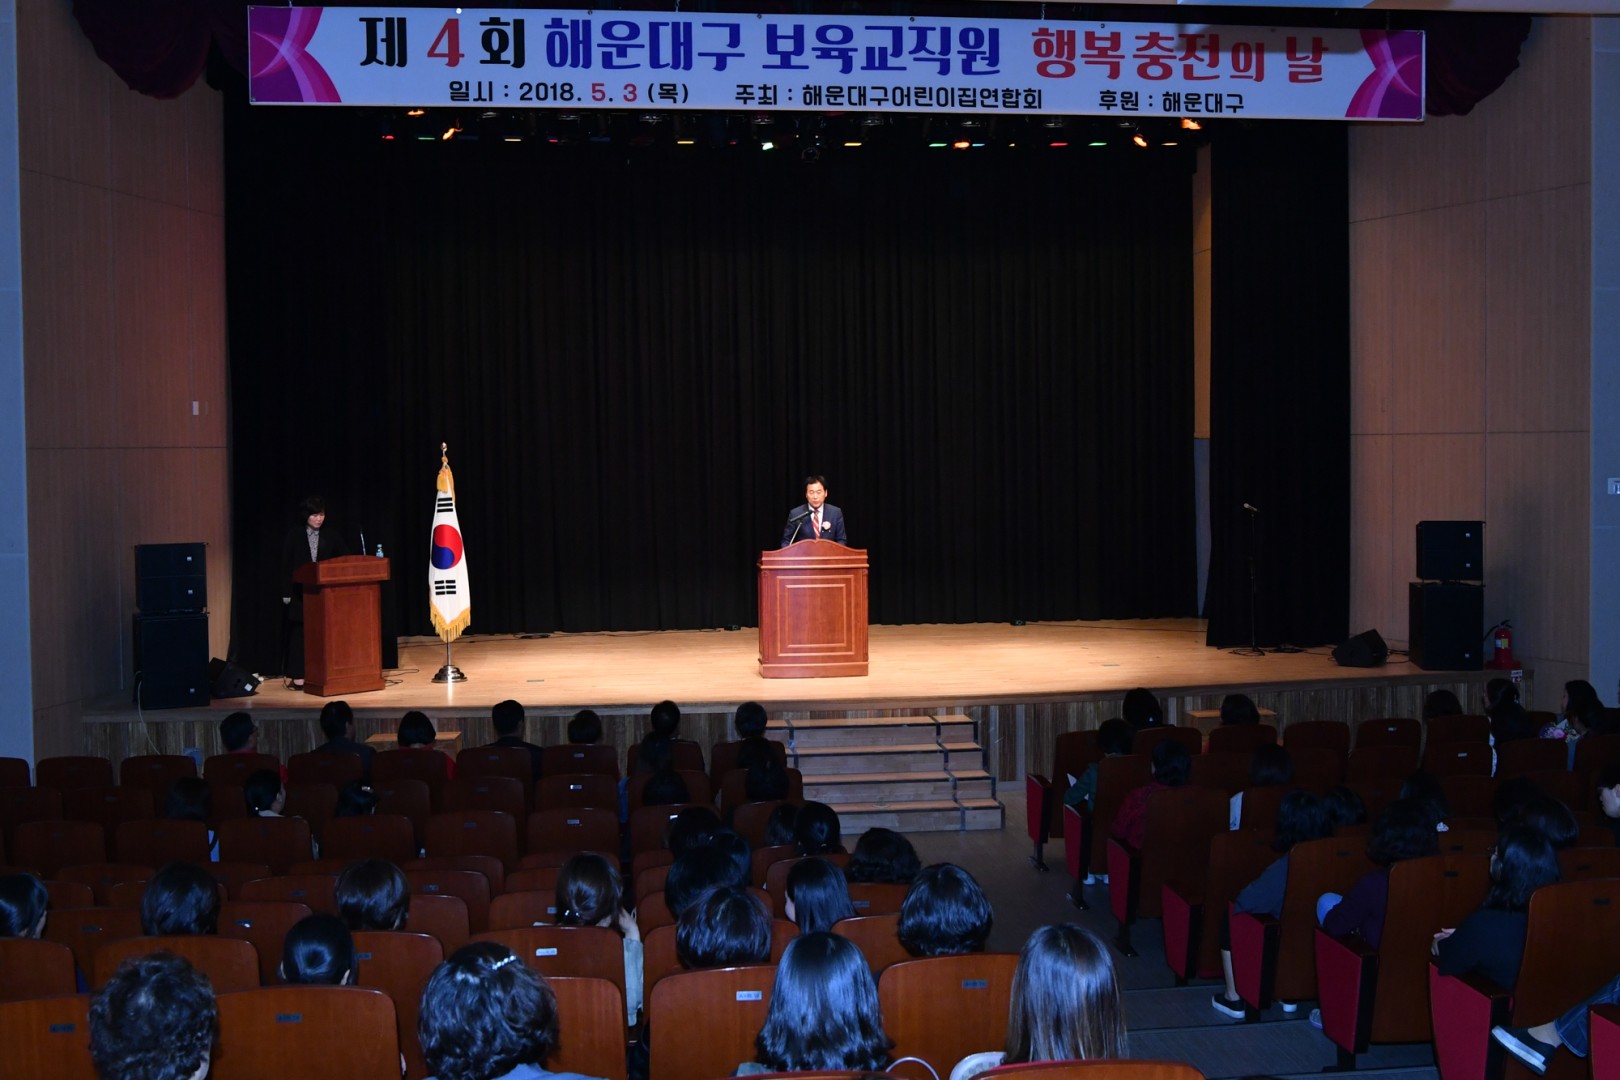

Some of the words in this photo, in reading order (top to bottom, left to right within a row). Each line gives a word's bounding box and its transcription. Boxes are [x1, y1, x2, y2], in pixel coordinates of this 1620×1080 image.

[358, 16, 408, 68] 제
[427, 18, 465, 68] 4
[479, 16, 526, 69] 회
[543, 17, 746, 72] 해운대구
[761, 23, 1001, 76] 보육교직원
[1031, 27, 1266, 83] 행복충전의
[1285, 36, 1329, 83] 날
[449, 80, 493, 102] 일시
[519, 81, 582, 102] 2018.
[591, 82, 614, 103] 5.
[623, 83, 638, 103] 3
[647, 82, 689, 104] (목)
[734, 83, 778, 106] 주최
[801, 84, 1042, 110] 해운대구어린이집연합회
[1098, 89, 1139, 112] 후원
[1161, 90, 1245, 114] 해운대구
